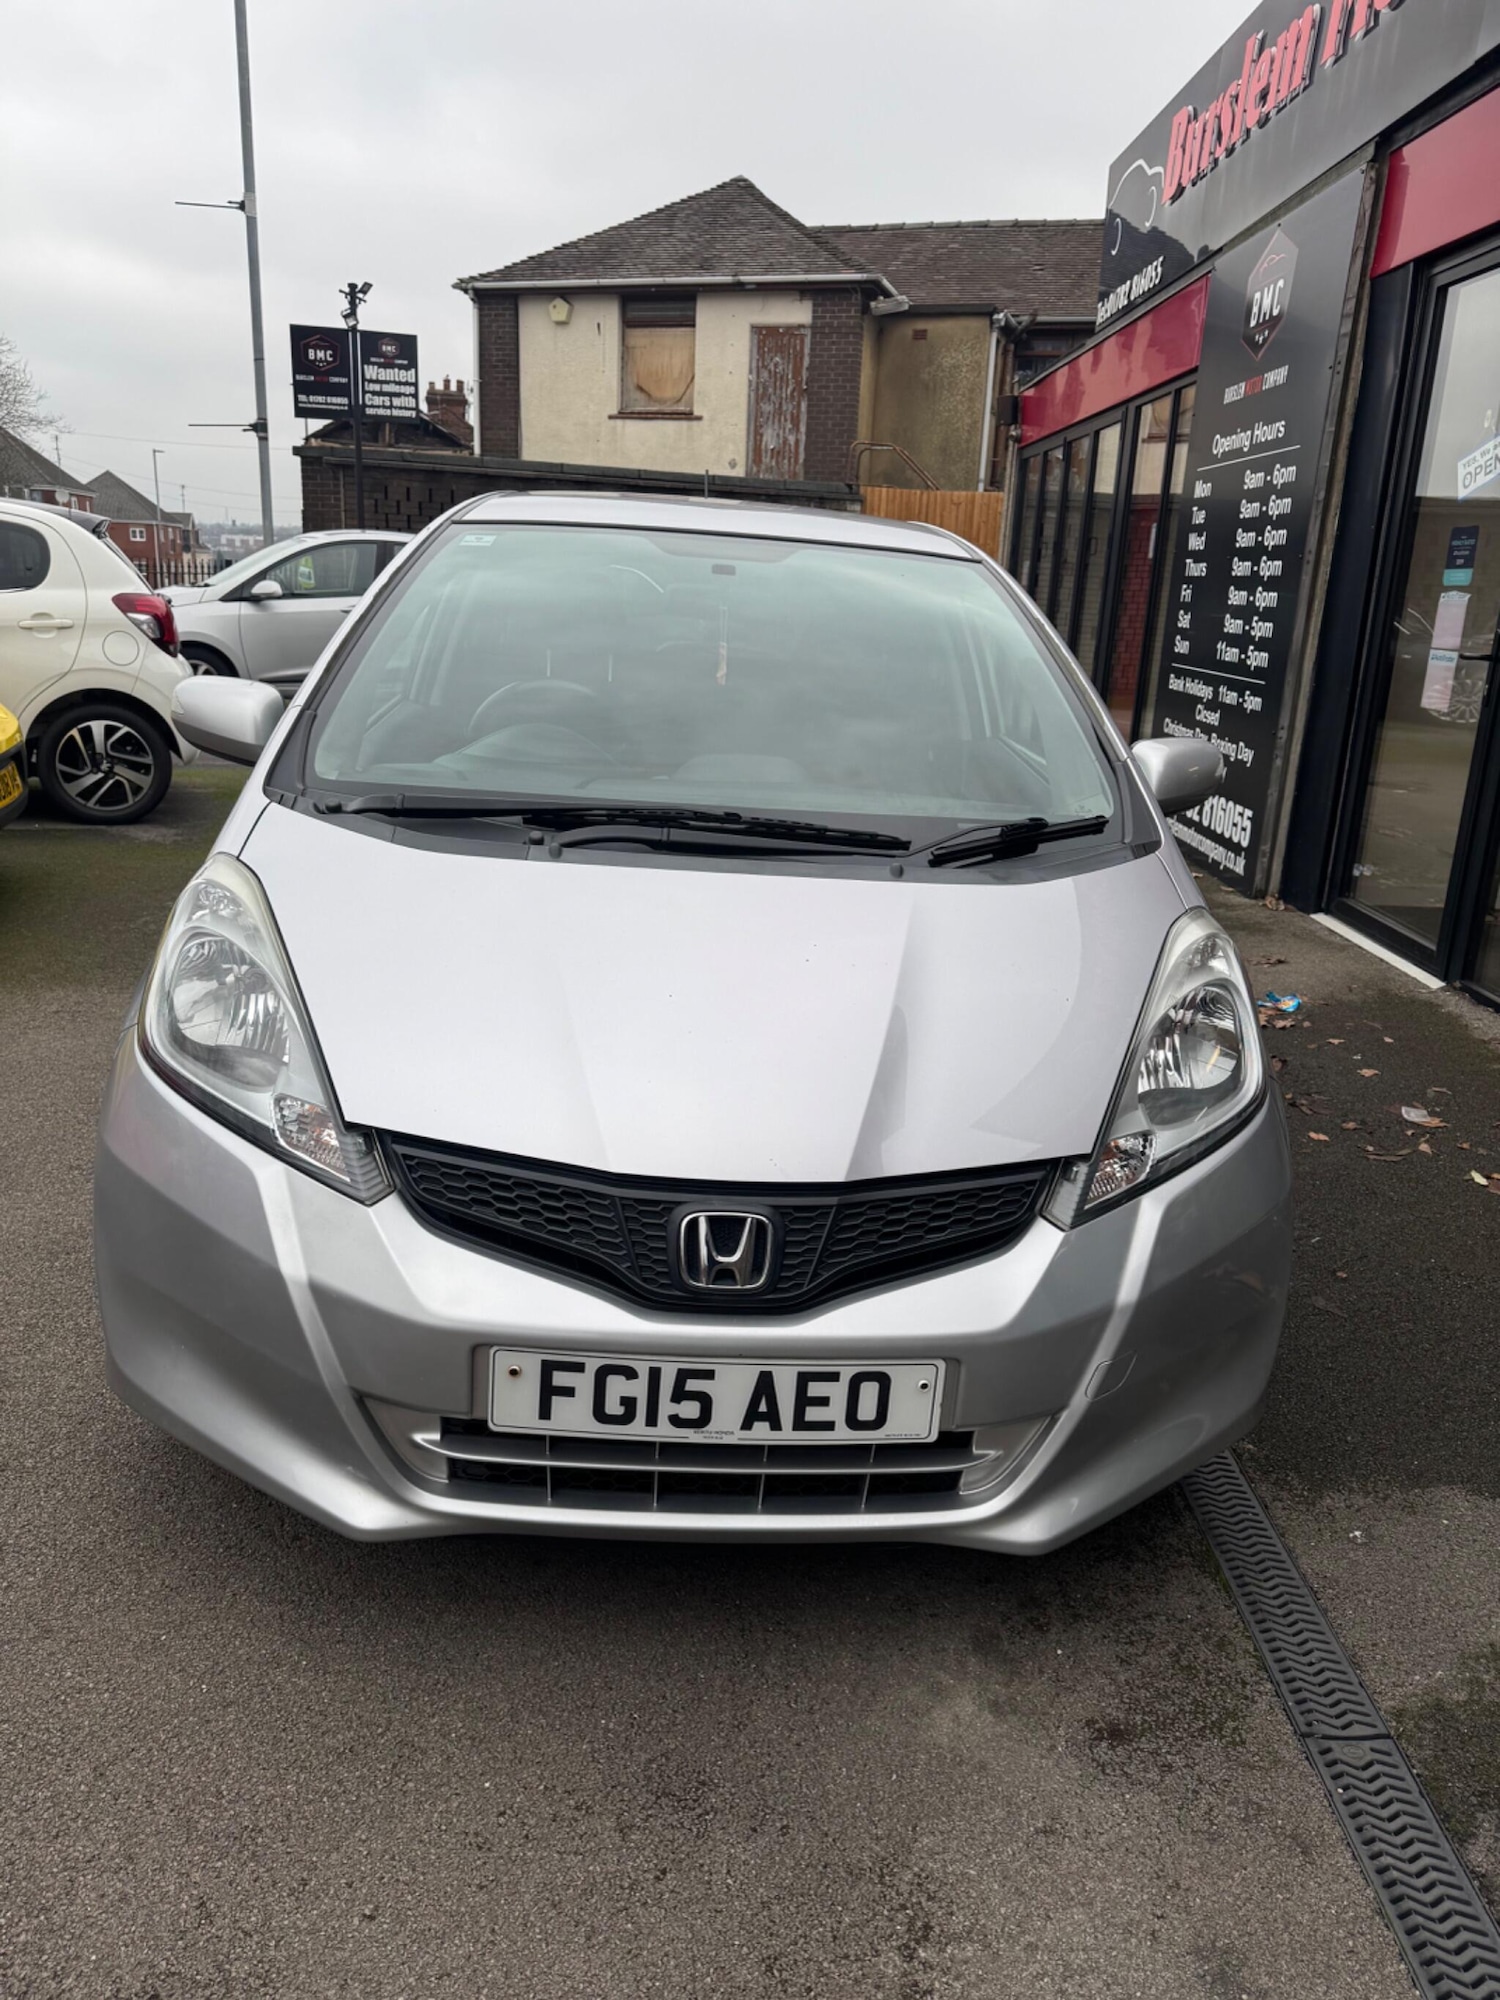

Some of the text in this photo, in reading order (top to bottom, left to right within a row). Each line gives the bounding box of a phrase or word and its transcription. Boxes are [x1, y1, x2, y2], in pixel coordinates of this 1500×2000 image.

[1161, 5, 1314, 206] Burslem
[1130, 255, 1164, 301] 816055
[1250, 278, 1284, 328] BMC
[308, 348, 334, 361] BMC
[363, 364, 416, 383] Wanted
[364, 381, 415, 395] Low mileage
[1262, 364, 1289, 391] COMPANY
[364, 393, 391, 406] Cars
[391, 395, 416, 408] with
[1212, 420, 1286, 459] Opening Hours
[1193, 480, 1212, 498] Mon
[1243, 470, 1265, 490] 9am
[1272, 463, 1297, 490] 6pm
[1191, 506, 1206, 525] Tue
[1239, 499, 1260, 520] 9am
[1268, 494, 1292, 520] 6pm
[1188, 531, 1206, 551] Wed
[1235, 528, 1256, 548] 9am
[1264, 525, 1288, 551] 6pm
[1185, 558, 1208, 577] Thurs
[1231, 557, 1252, 577] 9am
[1259, 556, 1283, 581] 6pm
[1180, 584, 1193, 603] Fri
[1227, 585, 1248, 606] 9am
[1254, 586, 1279, 612] 6pm
[1177, 609, 1192, 629] Sat
[1223, 614, 1243, 635] 9am
[1250, 616, 1274, 641] 5pm
[1174, 634, 1190, 654] Sun
[1216, 640, 1240, 663] 11am
[1246, 646, 1270, 671] 5pm
[1168, 674, 1185, 692] Bank
[1185, 676, 1214, 703] Holidays
[1218, 684, 1238, 706] 11am
[1243, 690, 1263, 714] 5pm
[1195, 703, 1221, 726] Closed
[1237, 741, 1255, 768] Day
[1202, 794, 1254, 848] 816055
[538, 1359, 893, 1432] FG15 AEO
